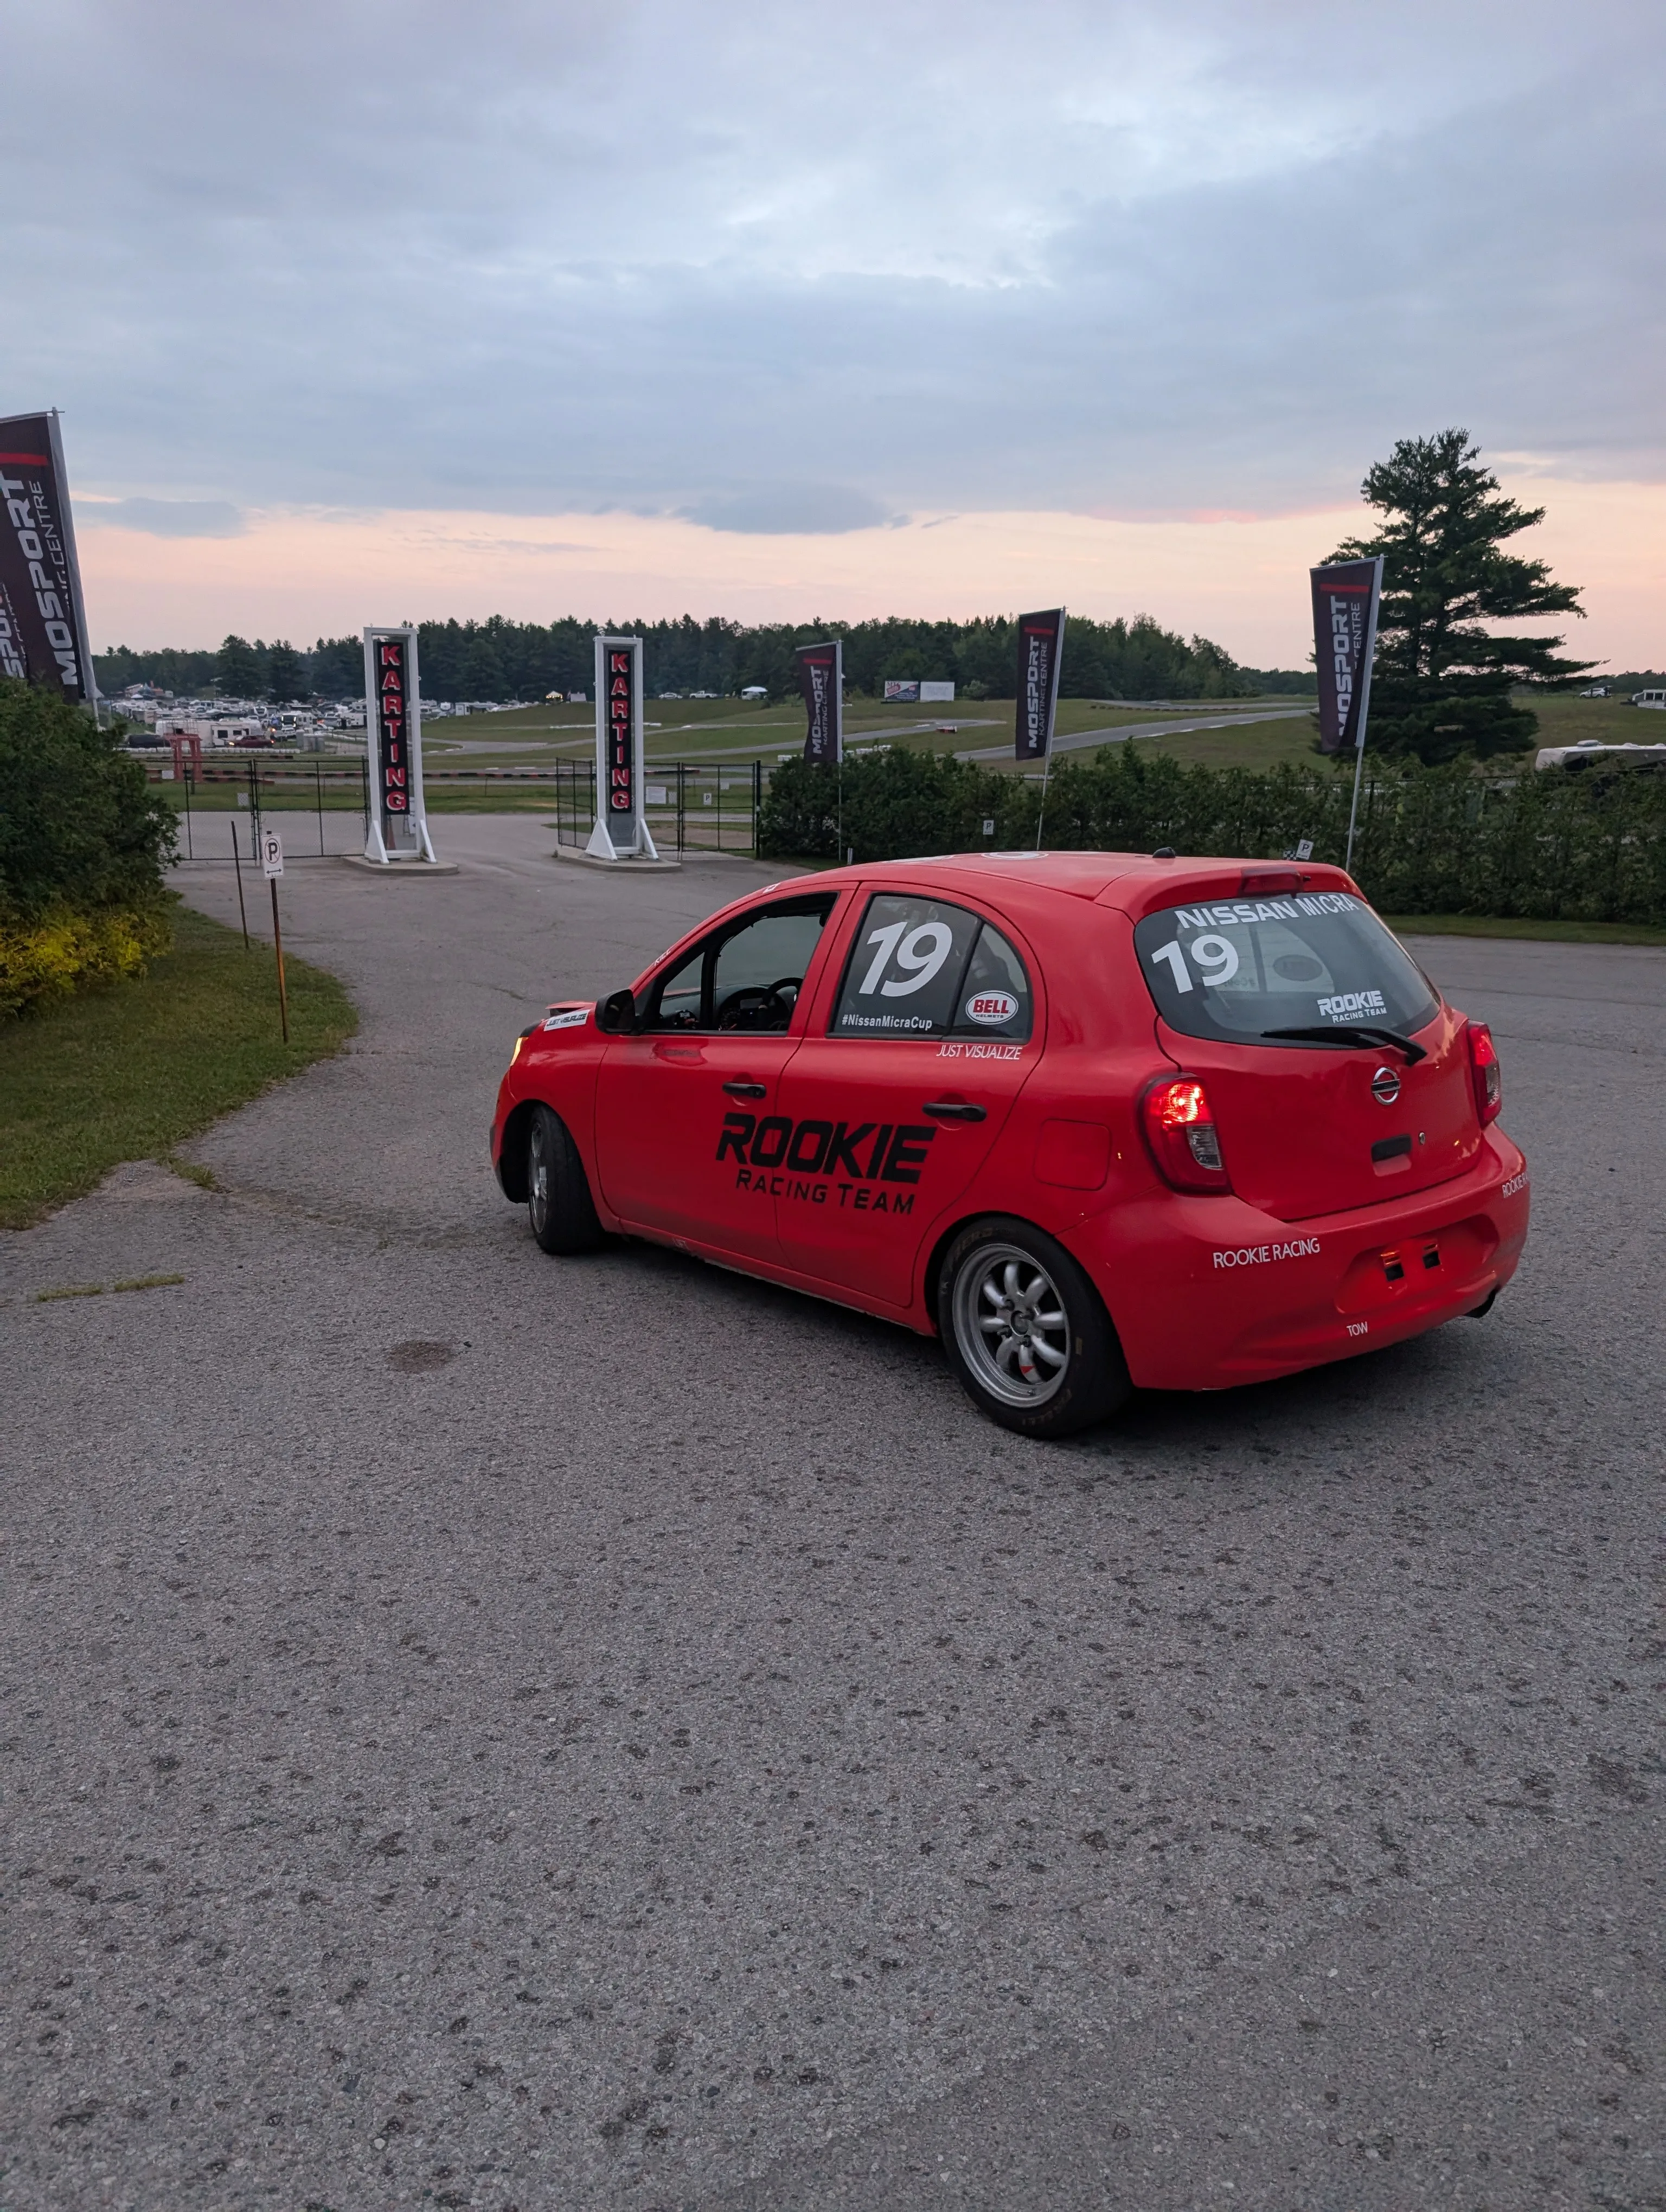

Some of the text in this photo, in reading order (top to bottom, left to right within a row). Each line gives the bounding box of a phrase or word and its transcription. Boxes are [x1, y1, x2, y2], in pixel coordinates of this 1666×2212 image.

[29, 480, 64, 565] CENTRE
[0, 470, 78, 685] MOSPORT
[1027, 636, 1039, 748] MOSPORT
[381, 645, 407, 811] KARTING
[611, 653, 630, 809] KARTING
[1174, 893, 1359, 929] NISSAN MICRA
[858, 922, 952, 997] 19
[1151, 934, 1239, 993] 19
[842, 1014, 932, 1031] #NissanMicraCup
[973, 999, 1009, 1014] BELL
[1317, 990, 1385, 1016] ROOKIE
[1332, 1007, 1387, 1024] RACING TEAM
[935, 1045, 1022, 1060] JUST VISUALIZE
[715, 1112, 937, 1185] ROOKIE
[735, 1168, 915, 1215] RACING TEAM
[1213, 1238, 1321, 1269] ROOKIE RACING
[1347, 1321, 1369, 1337] TOW
